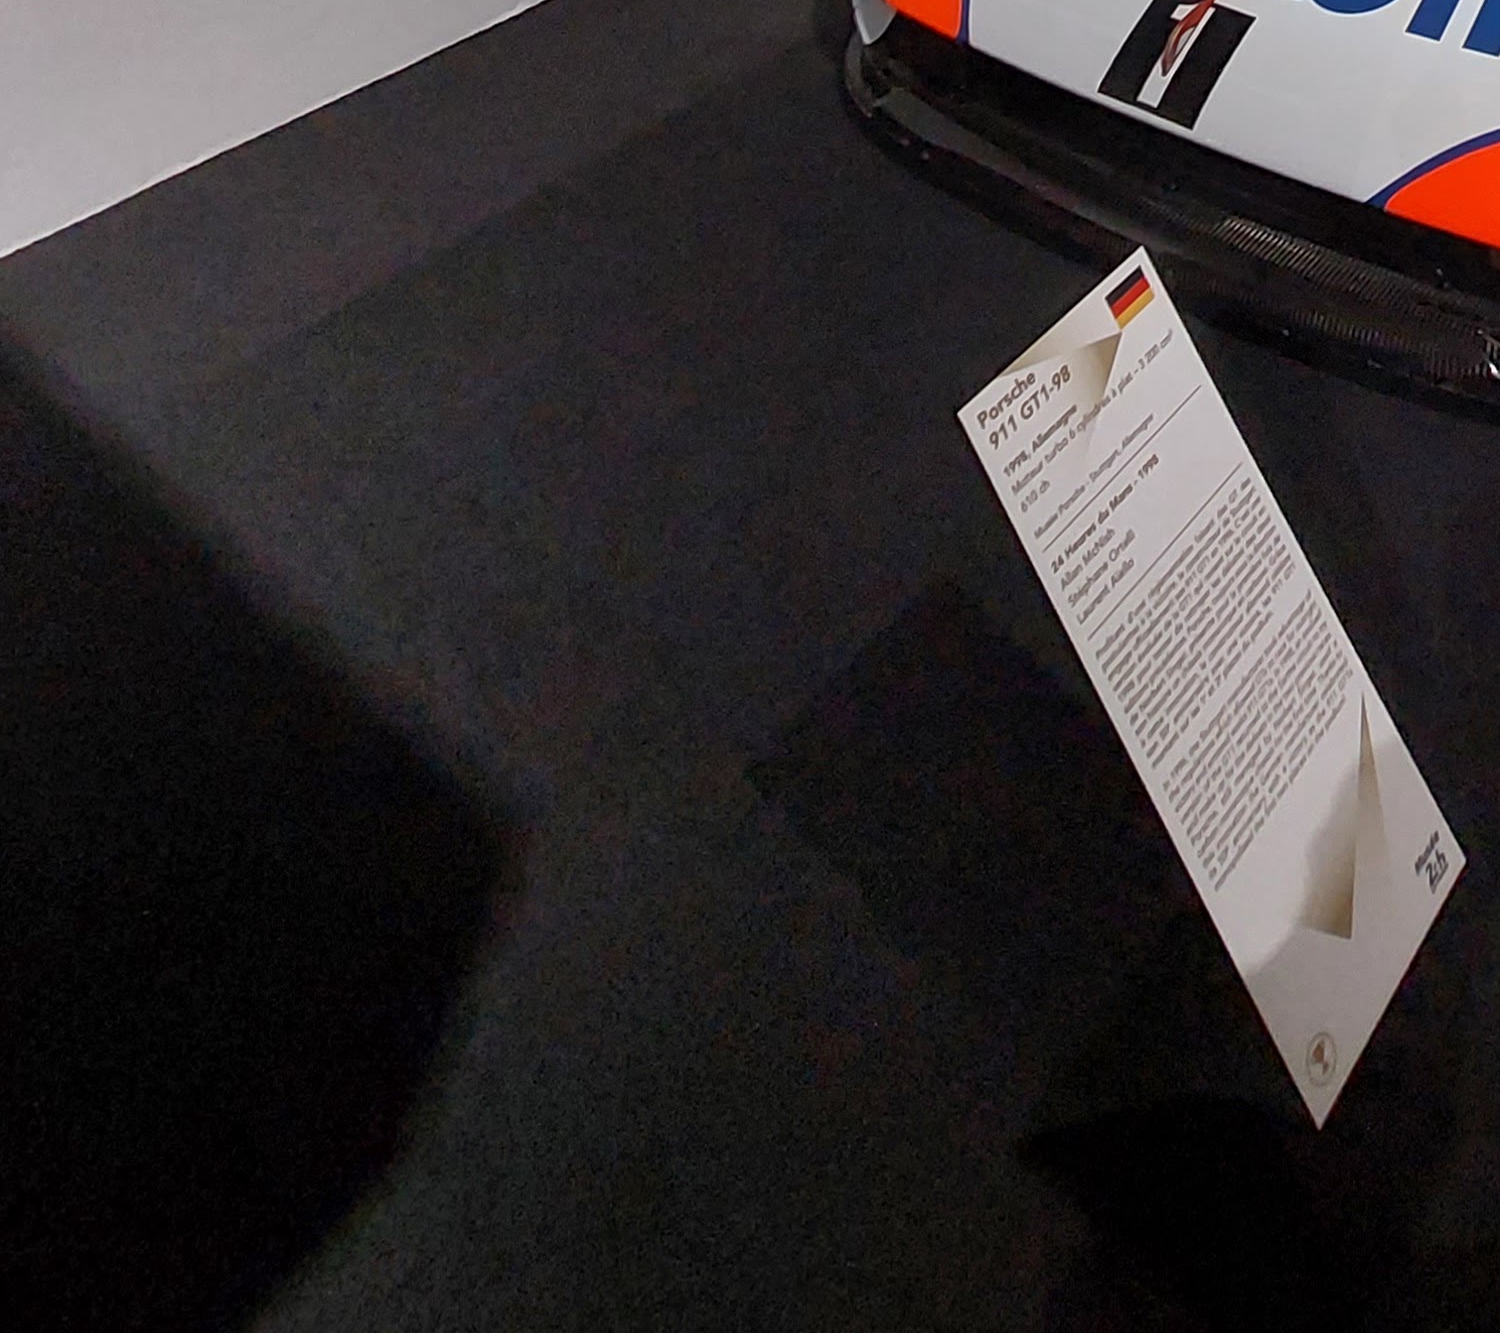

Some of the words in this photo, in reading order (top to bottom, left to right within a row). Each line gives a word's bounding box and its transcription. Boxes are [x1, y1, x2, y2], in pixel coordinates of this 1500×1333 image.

[1136, 2, 1215, 109] 1
[976, 372, 1036, 431] Porsche
[988, 413, 1018, 451] 911
[1019, 364, 1071, 421] GT1-98
